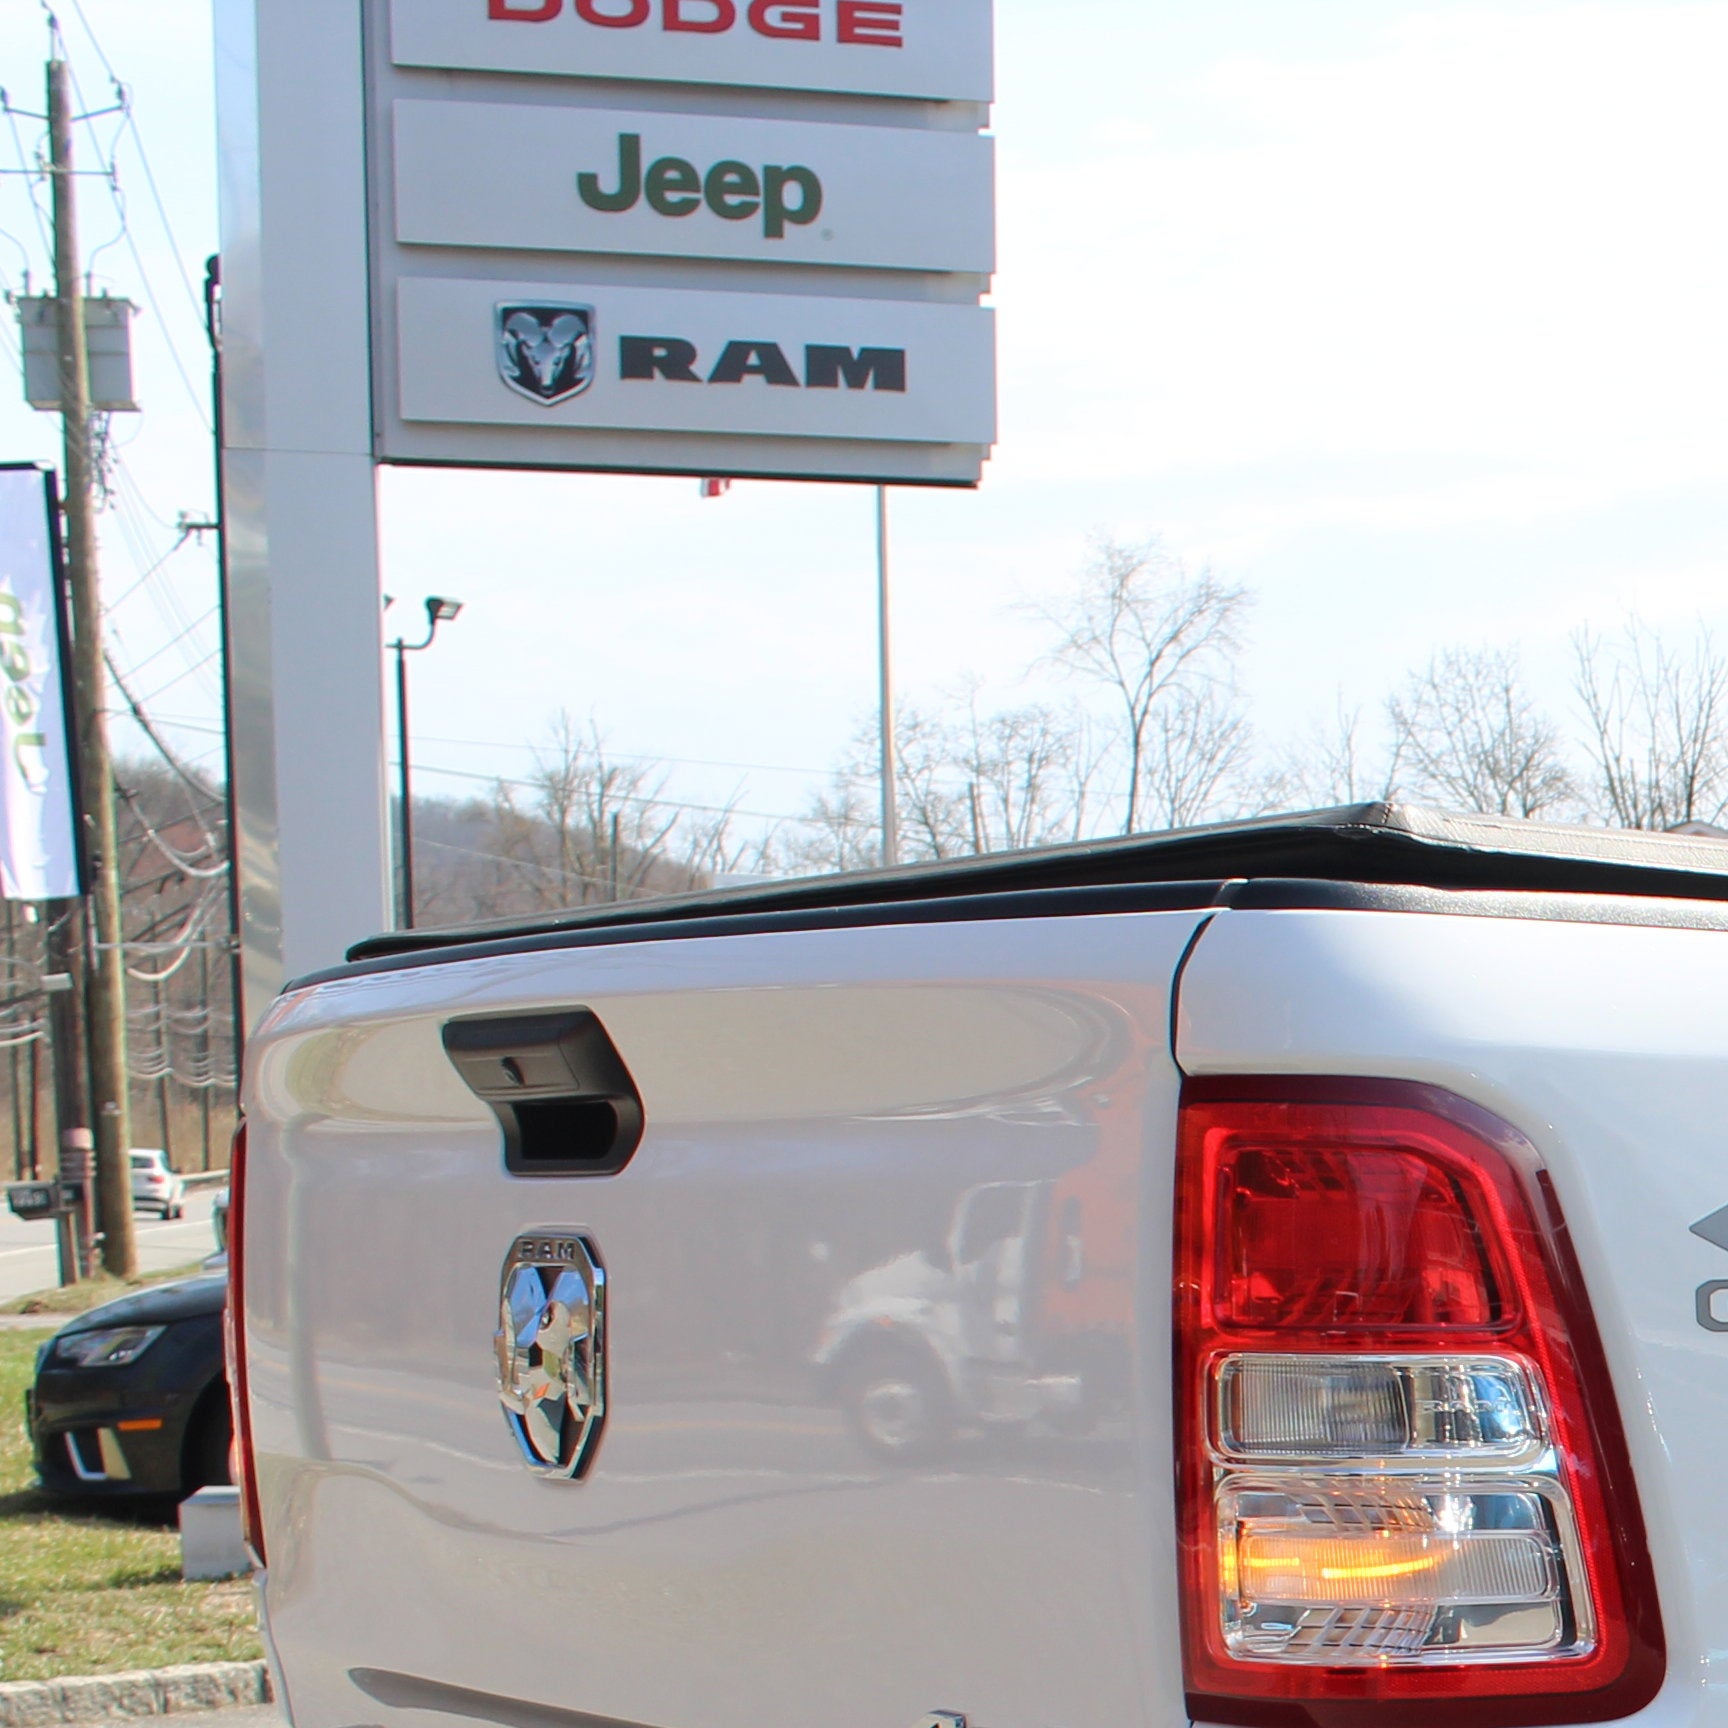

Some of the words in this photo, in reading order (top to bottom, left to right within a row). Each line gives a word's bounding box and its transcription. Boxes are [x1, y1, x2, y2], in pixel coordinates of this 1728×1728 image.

[577, 133, 822, 239] Jeep
[619, 335, 906, 393] RAM
[518, 1240, 575, 1260] RAM
